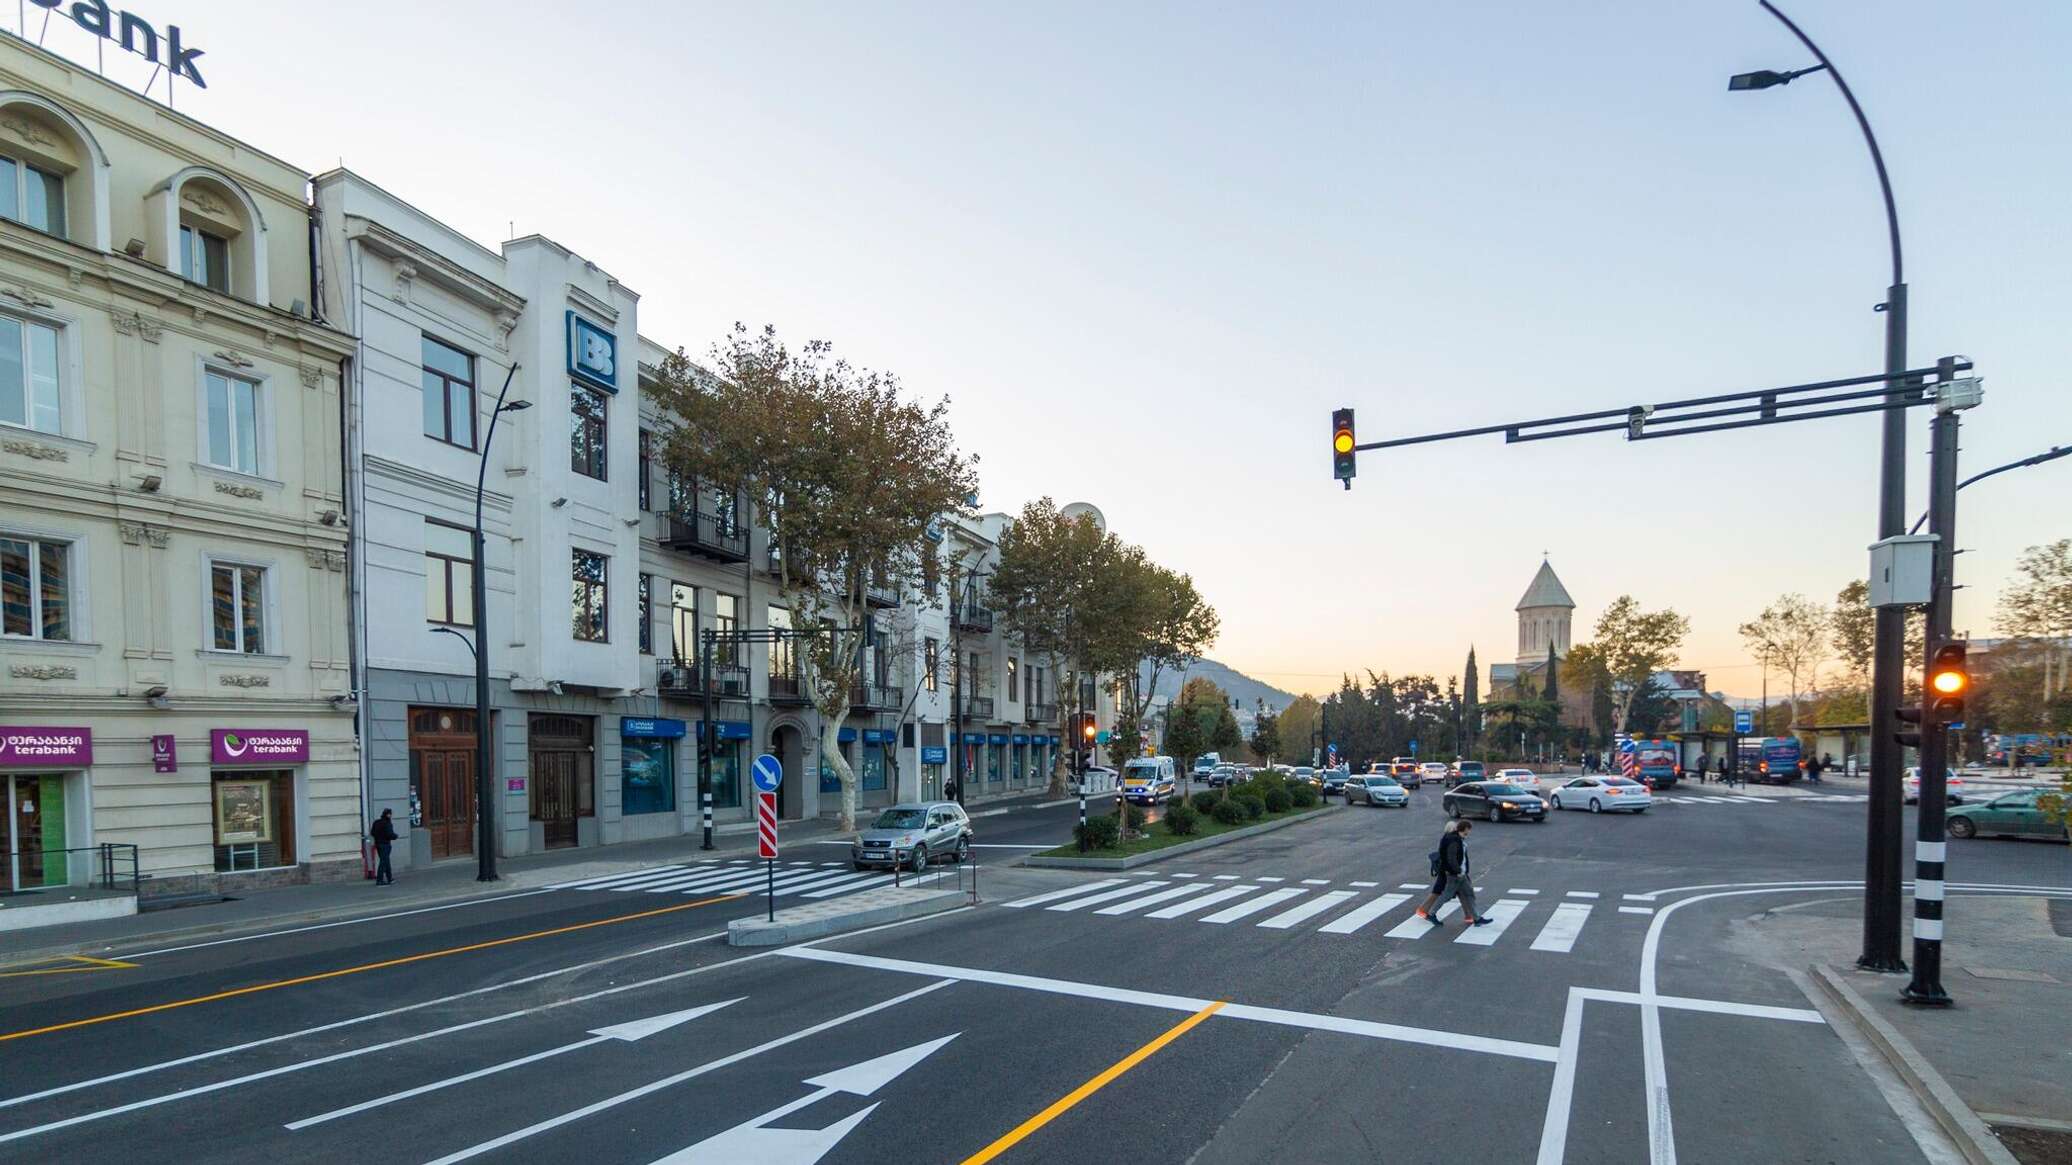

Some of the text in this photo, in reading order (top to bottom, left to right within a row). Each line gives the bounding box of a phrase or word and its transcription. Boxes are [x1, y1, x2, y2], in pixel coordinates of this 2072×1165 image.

[29, 0, 207, 89] ank
[8, 735, 83, 745] ტერაბანკი
[248, 736, 302, 745] ტერაბანკი
[15, 745, 77, 755] terabank
[253, 745, 298, 754] terabank
